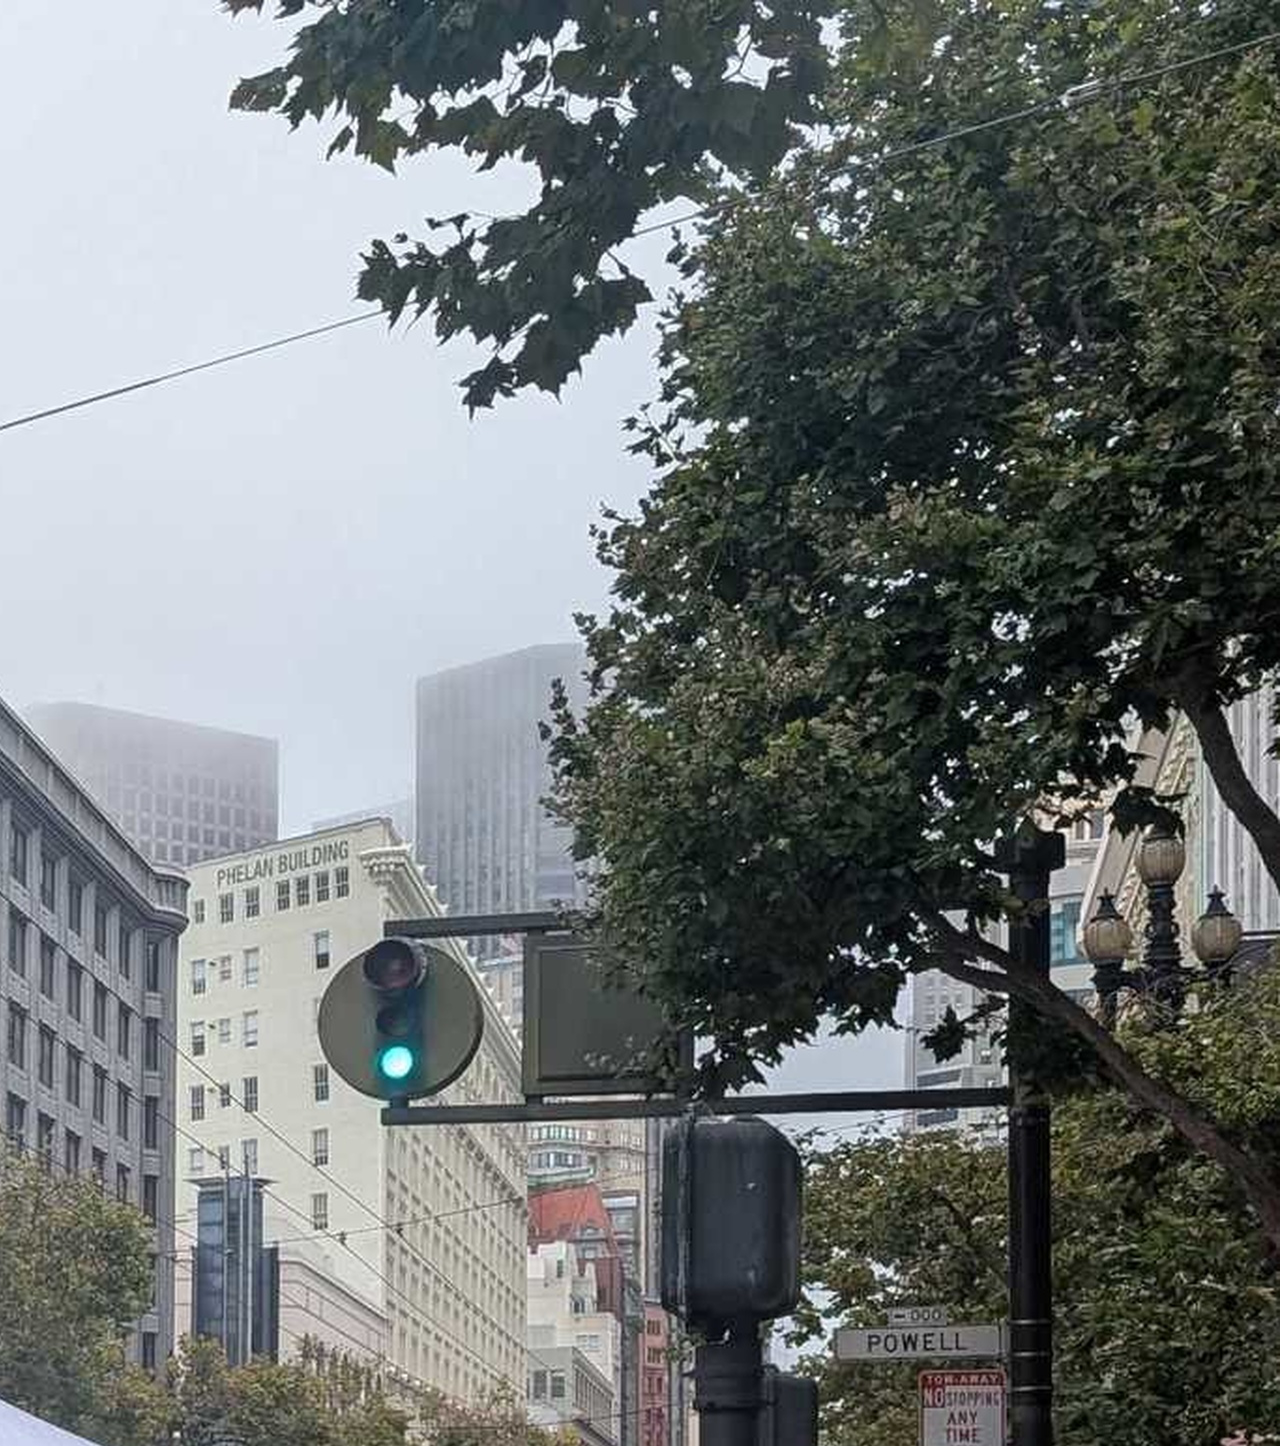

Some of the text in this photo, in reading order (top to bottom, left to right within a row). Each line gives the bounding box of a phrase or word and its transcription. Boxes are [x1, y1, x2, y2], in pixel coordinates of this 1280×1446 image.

[217, 840, 349, 887] PHELAN BUILDING
[867, 1332, 967, 1353] POWELL
[924, 1388, 1002, 1407] NO STOPPING
[946, 1410, 978, 1425] ANY
[946, 1427, 980, 1443] TIME
